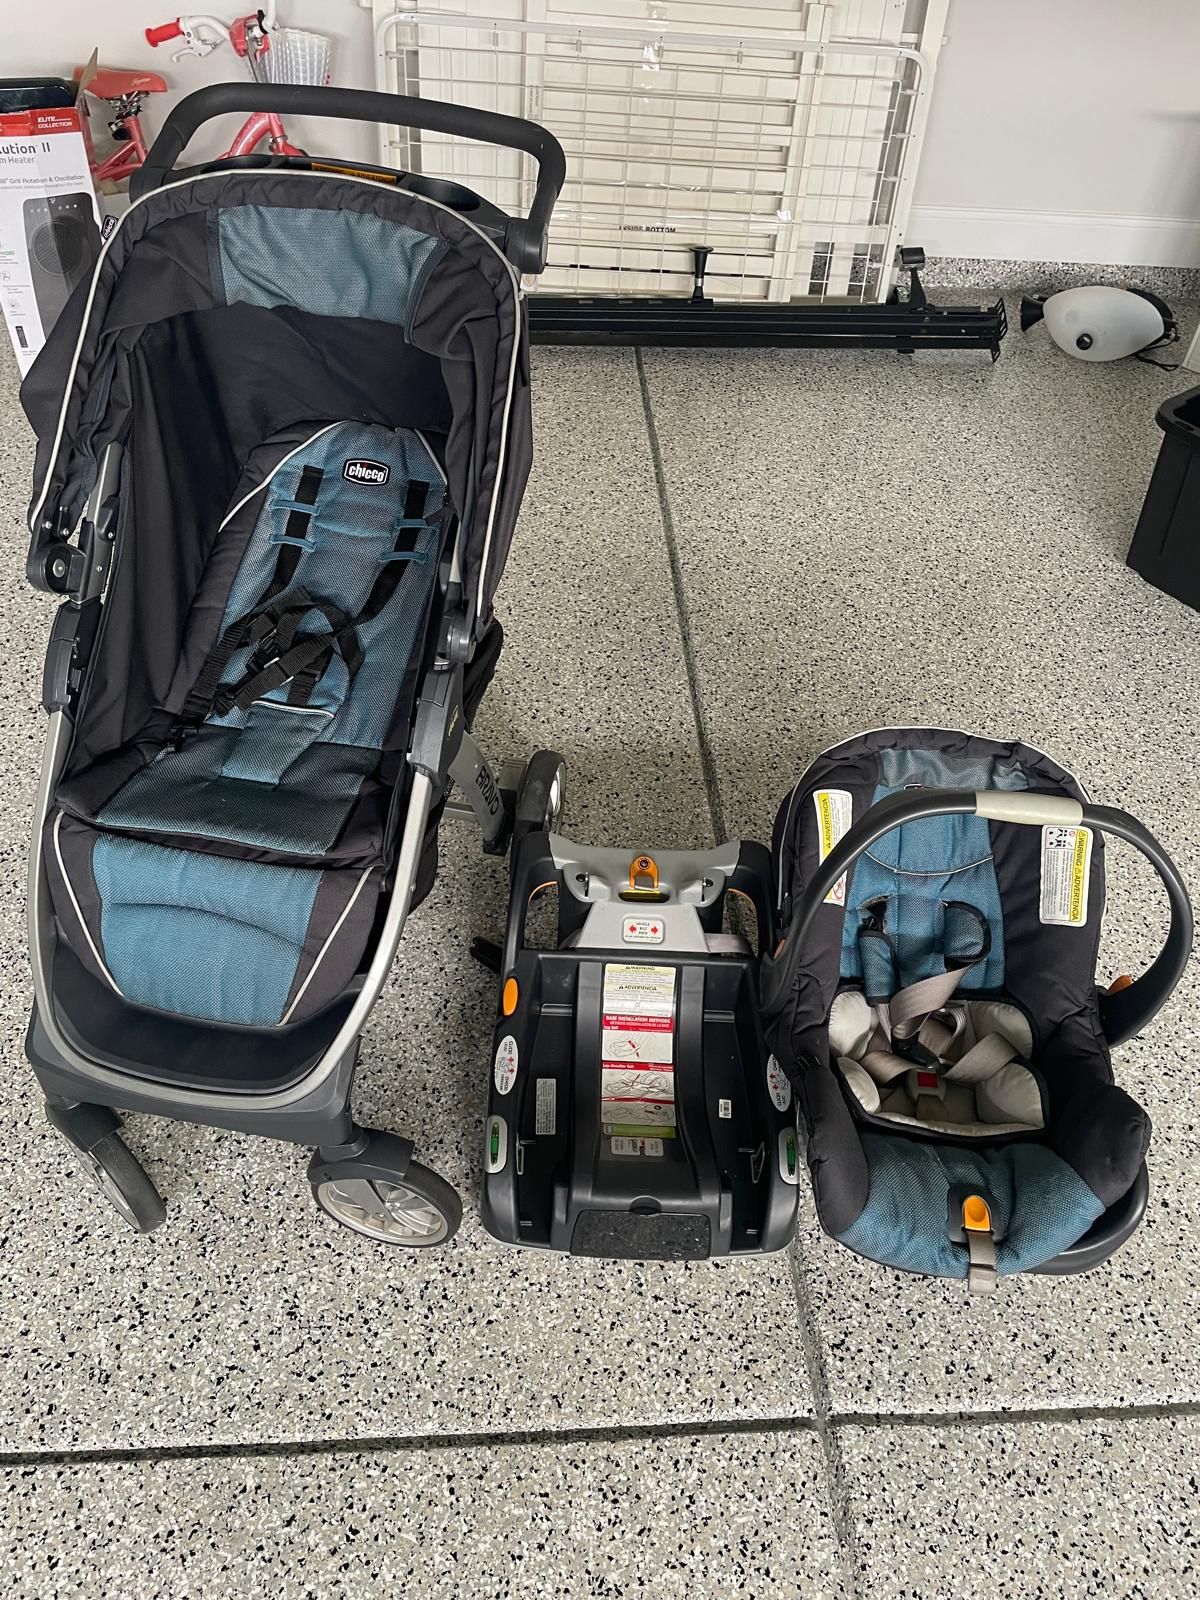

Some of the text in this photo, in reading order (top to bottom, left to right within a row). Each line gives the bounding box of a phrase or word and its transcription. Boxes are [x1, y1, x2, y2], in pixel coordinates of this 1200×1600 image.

[37, 121, 73, 129] COLLECTION
[0, 143, 36, 154] ution
[8, 156, 35, 164] Heater
[348, 463, 386, 482] chicco
[475, 765, 500, 816] BRAVO
[822, 798, 831, 841] ADVERTENCIA
[1071, 837, 1085, 921] WARNING ADVERTENCIA
